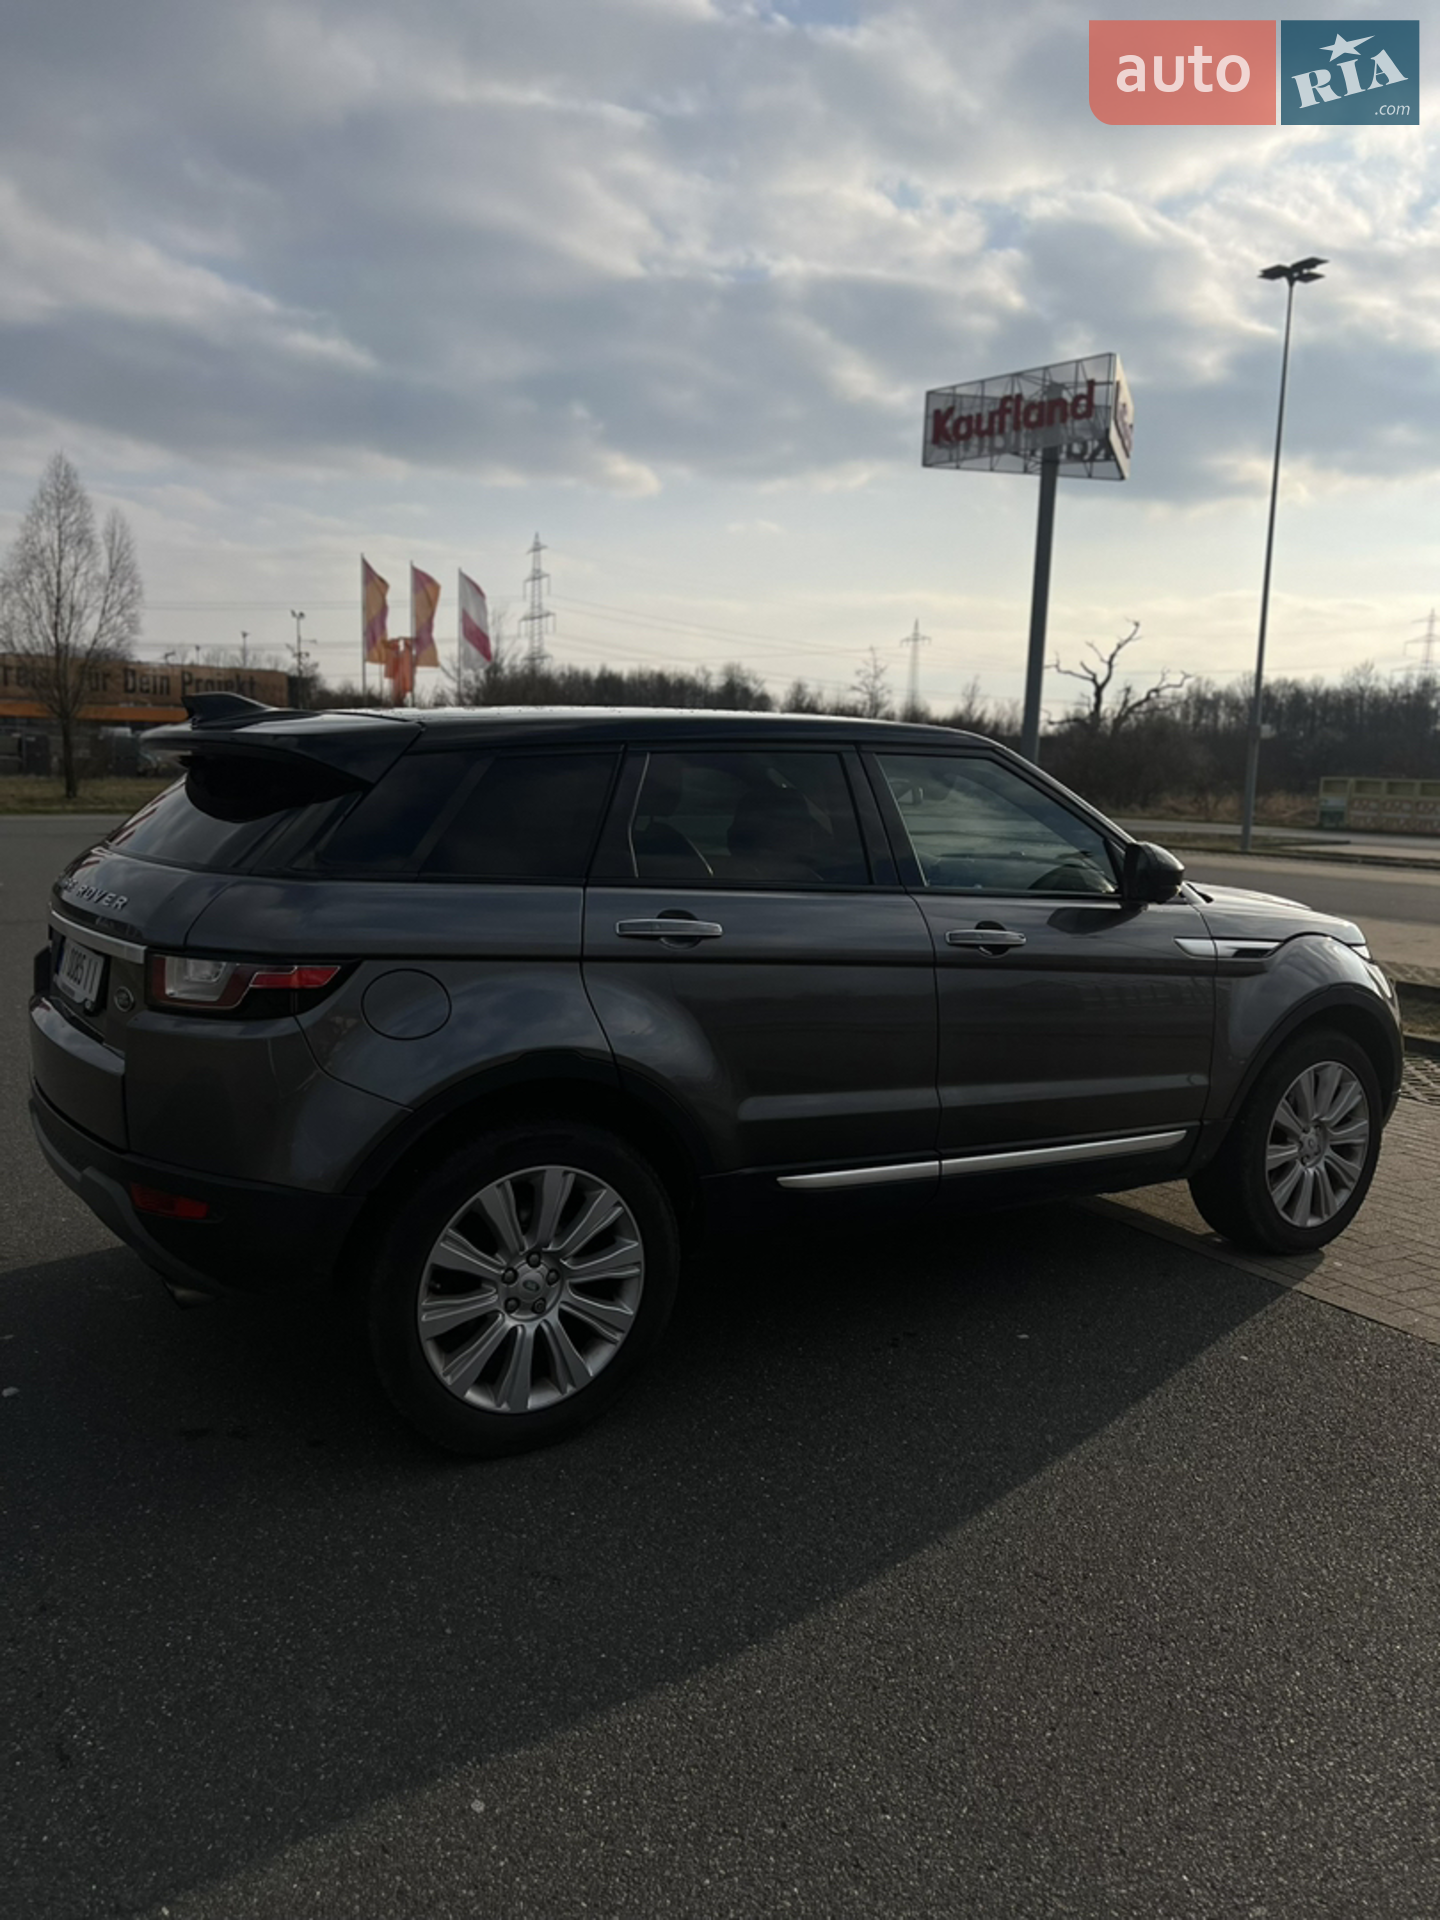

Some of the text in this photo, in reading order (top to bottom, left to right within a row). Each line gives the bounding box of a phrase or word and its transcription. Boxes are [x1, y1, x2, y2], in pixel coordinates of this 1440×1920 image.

[931, 378, 1096, 446] Kaufland
[123, 668, 172, 696] Dein
[181, 670, 258, 698] Projekt
[76, 884, 129, 910] ROVER
